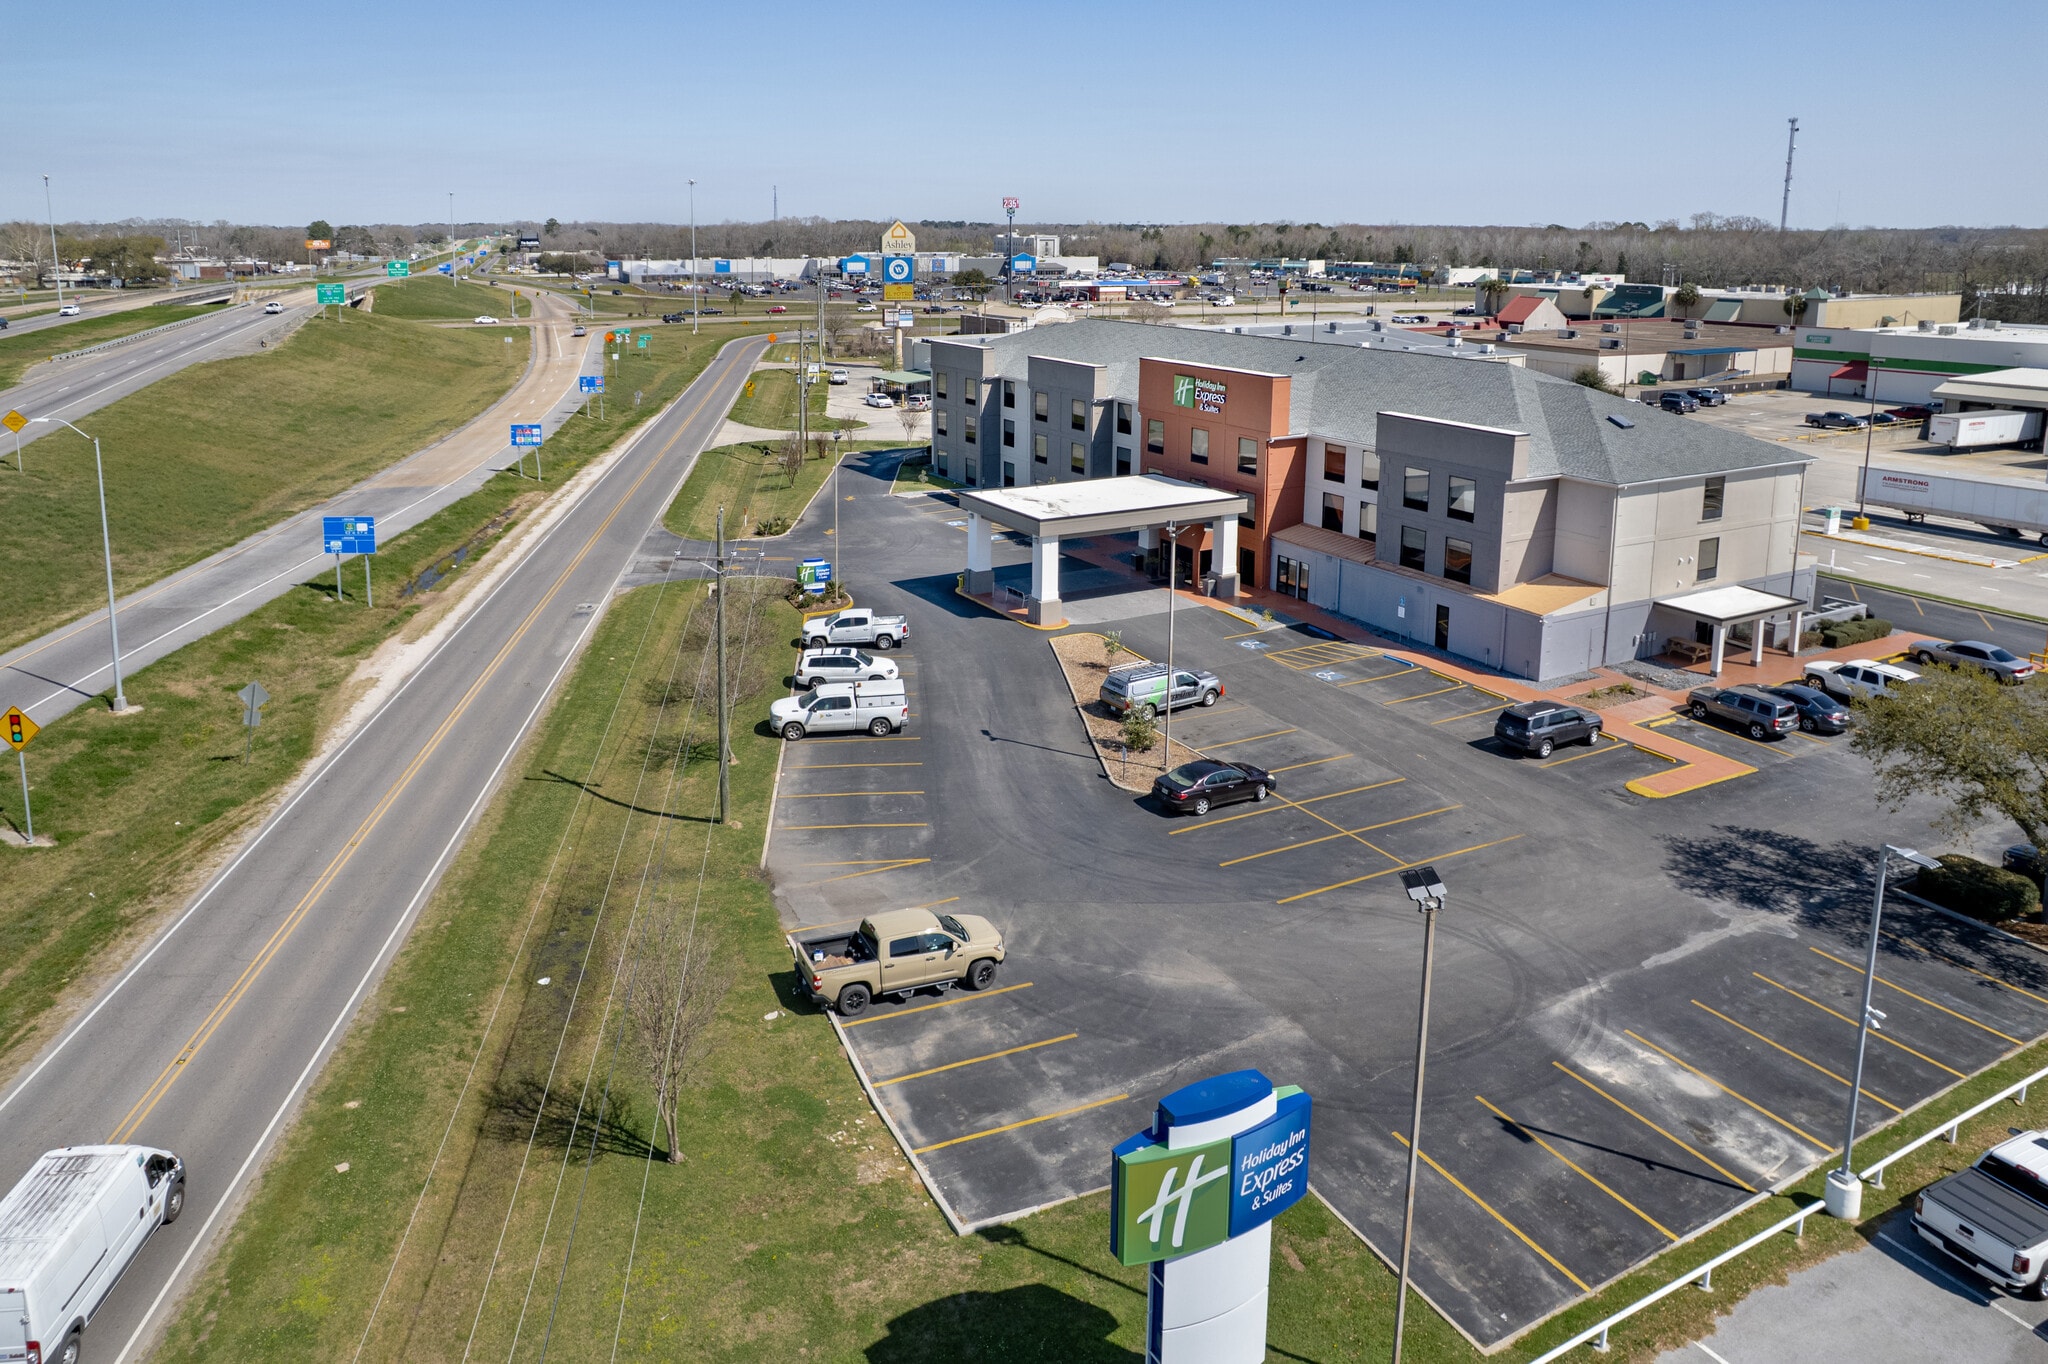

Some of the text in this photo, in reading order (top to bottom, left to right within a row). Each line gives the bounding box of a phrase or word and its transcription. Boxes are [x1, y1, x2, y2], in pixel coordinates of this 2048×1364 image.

[884, 240, 913, 250] Ashley
[1195, 378, 1226, 392] Holiday Inn
[1195, 388, 1226, 404] Express
[1199, 403, 1220, 413] & Suites
[1882, 475, 1929, 487] ARMSTRONG
[1241, 1128, 1305, 1171] Holiday Inn
[1240, 1148, 1305, 1197] Express
[1251, 1179, 1293, 1211] & Suites
